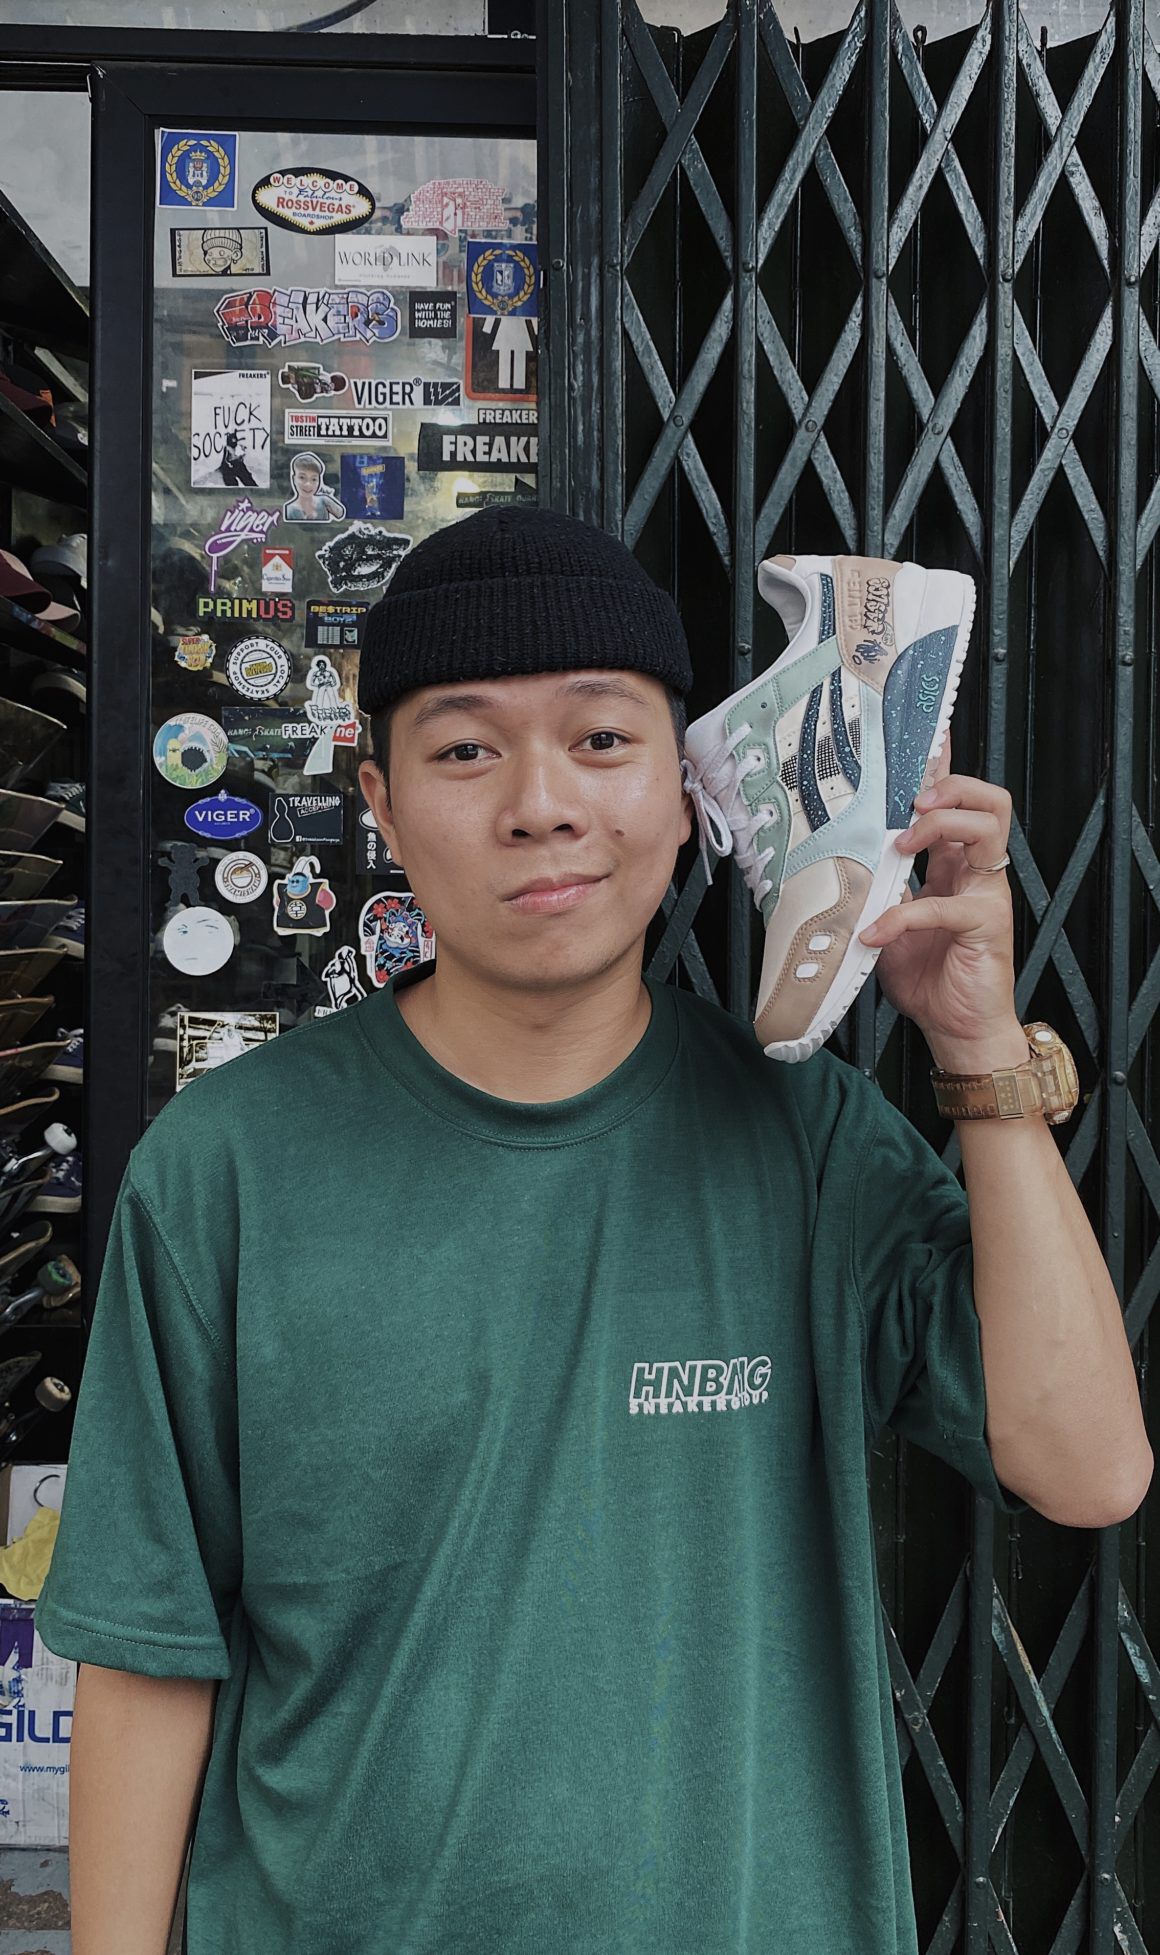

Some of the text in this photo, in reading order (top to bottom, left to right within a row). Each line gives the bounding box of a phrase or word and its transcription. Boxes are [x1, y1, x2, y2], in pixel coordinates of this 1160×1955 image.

[272, 176, 355, 191] WELCOME
[277, 197, 352, 215] ROSSVEGAS
[292, 211, 334, 221] BOARDSHOP
[399, 252, 433, 267] LINK
[415, 302, 452, 311] HAVE FUN
[415, 311, 452, 319] WITH THE
[213, 401, 262, 430] FUCK
[290, 414, 317, 423] TUSTIN
[478, 409, 538, 424] FREAKER
[290, 417, 387, 437] STREET TATTOO
[193, 427, 270, 460] SOCETY
[198, 598, 292, 619] PRIMUS
[233, 642, 259, 665] SUPPORT
[265, 643, 282, 660] YOUR
[232, 670, 270, 695] SKATESHOP
[273, 664, 285, 687] LOCAL
[916, 674, 940, 713] asics
[195, 810, 250, 822] VIGER
